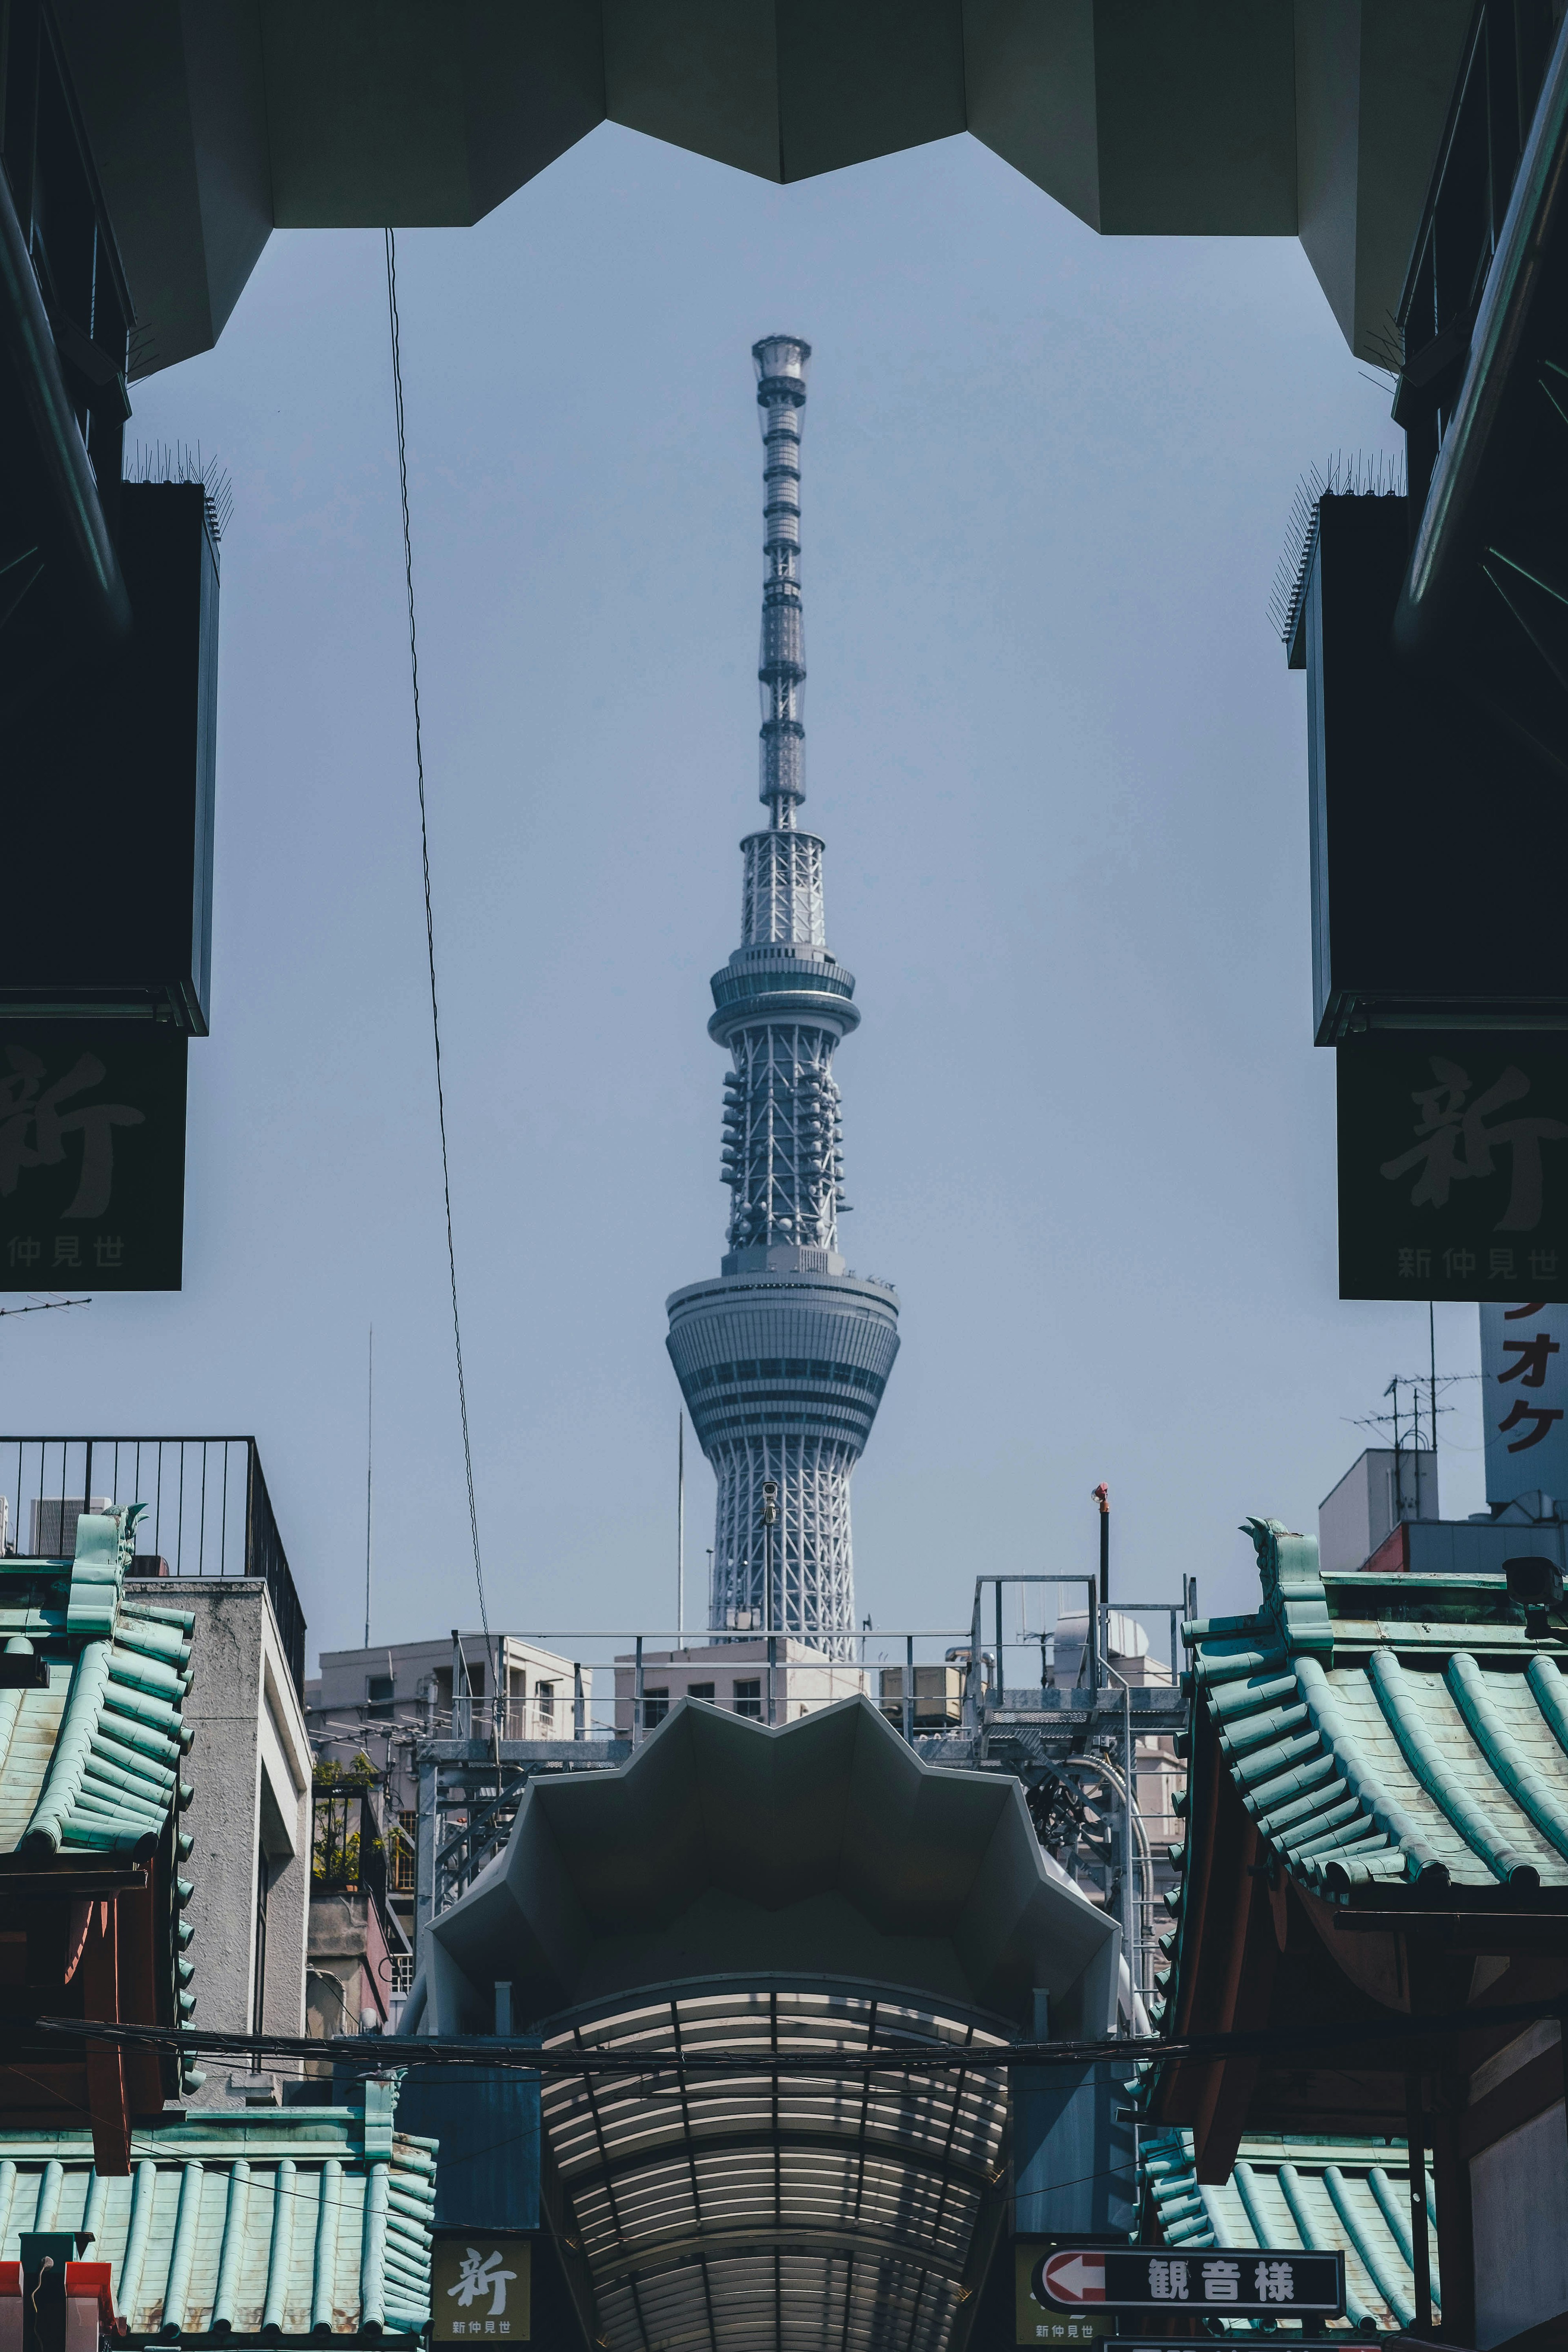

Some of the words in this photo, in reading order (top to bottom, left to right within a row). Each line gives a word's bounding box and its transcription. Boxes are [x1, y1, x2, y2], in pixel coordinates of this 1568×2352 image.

[1380, 1056, 1568, 1232] 新
[7, 1236, 125, 1267] 仲見世
[1398, 1247, 1559, 1280] 新仲見世
[447, 2247, 517, 2315] 新
[1148, 2258, 1294, 2302] 観音様
[452, 2321, 511, 2334] 新仲見世
[1036, 2325, 1093, 2338] 新仲見世
